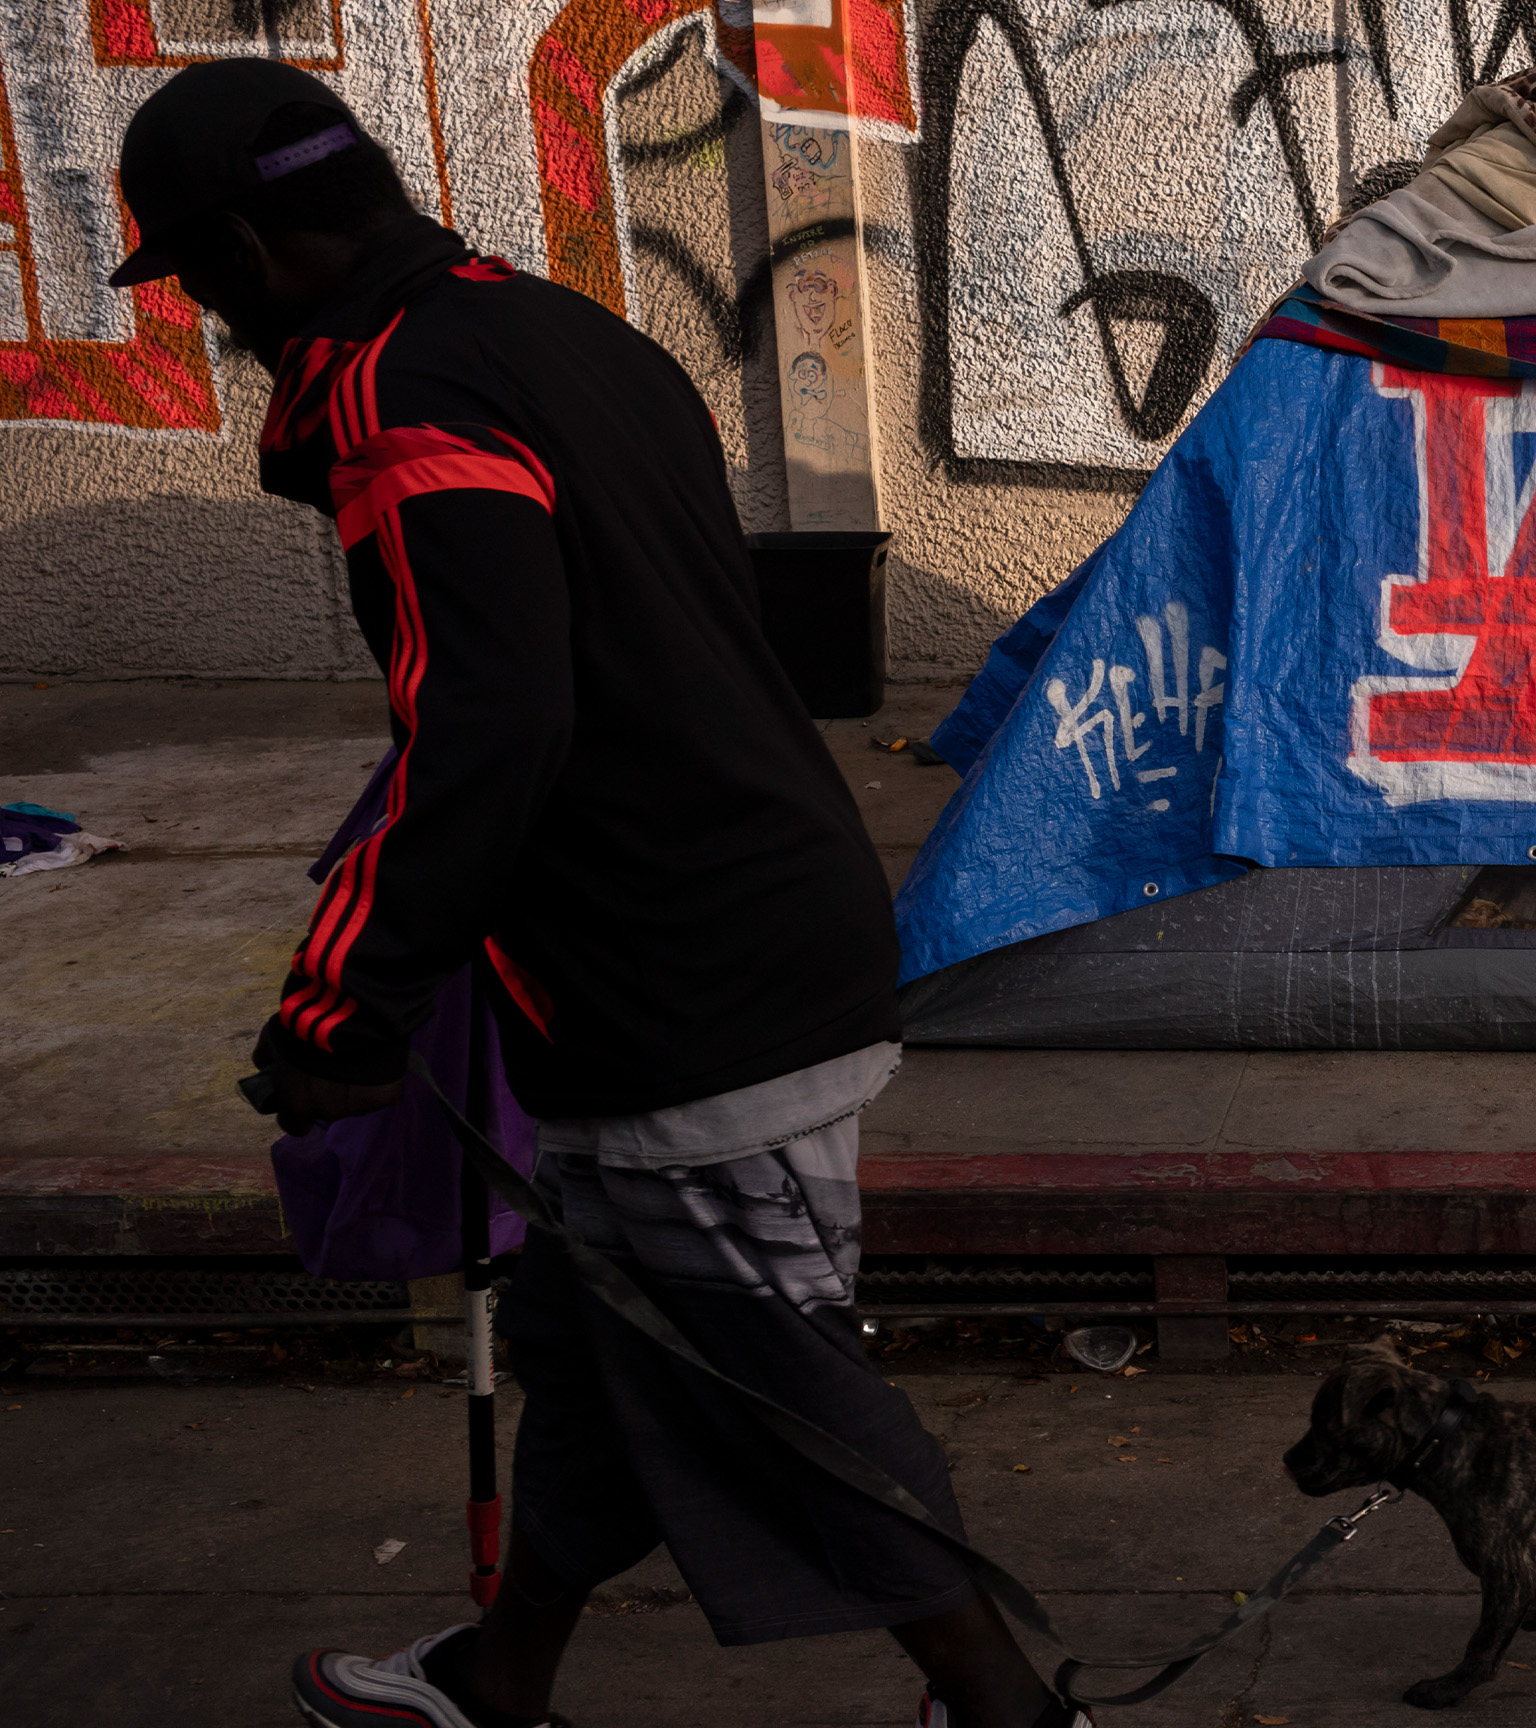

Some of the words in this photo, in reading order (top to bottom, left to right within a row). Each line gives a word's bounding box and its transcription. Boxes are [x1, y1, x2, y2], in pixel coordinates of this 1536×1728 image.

[782, 226, 825, 246] INSPIRE
[800, 240, 816, 250] OR
[829, 319, 852, 342] FLACO
